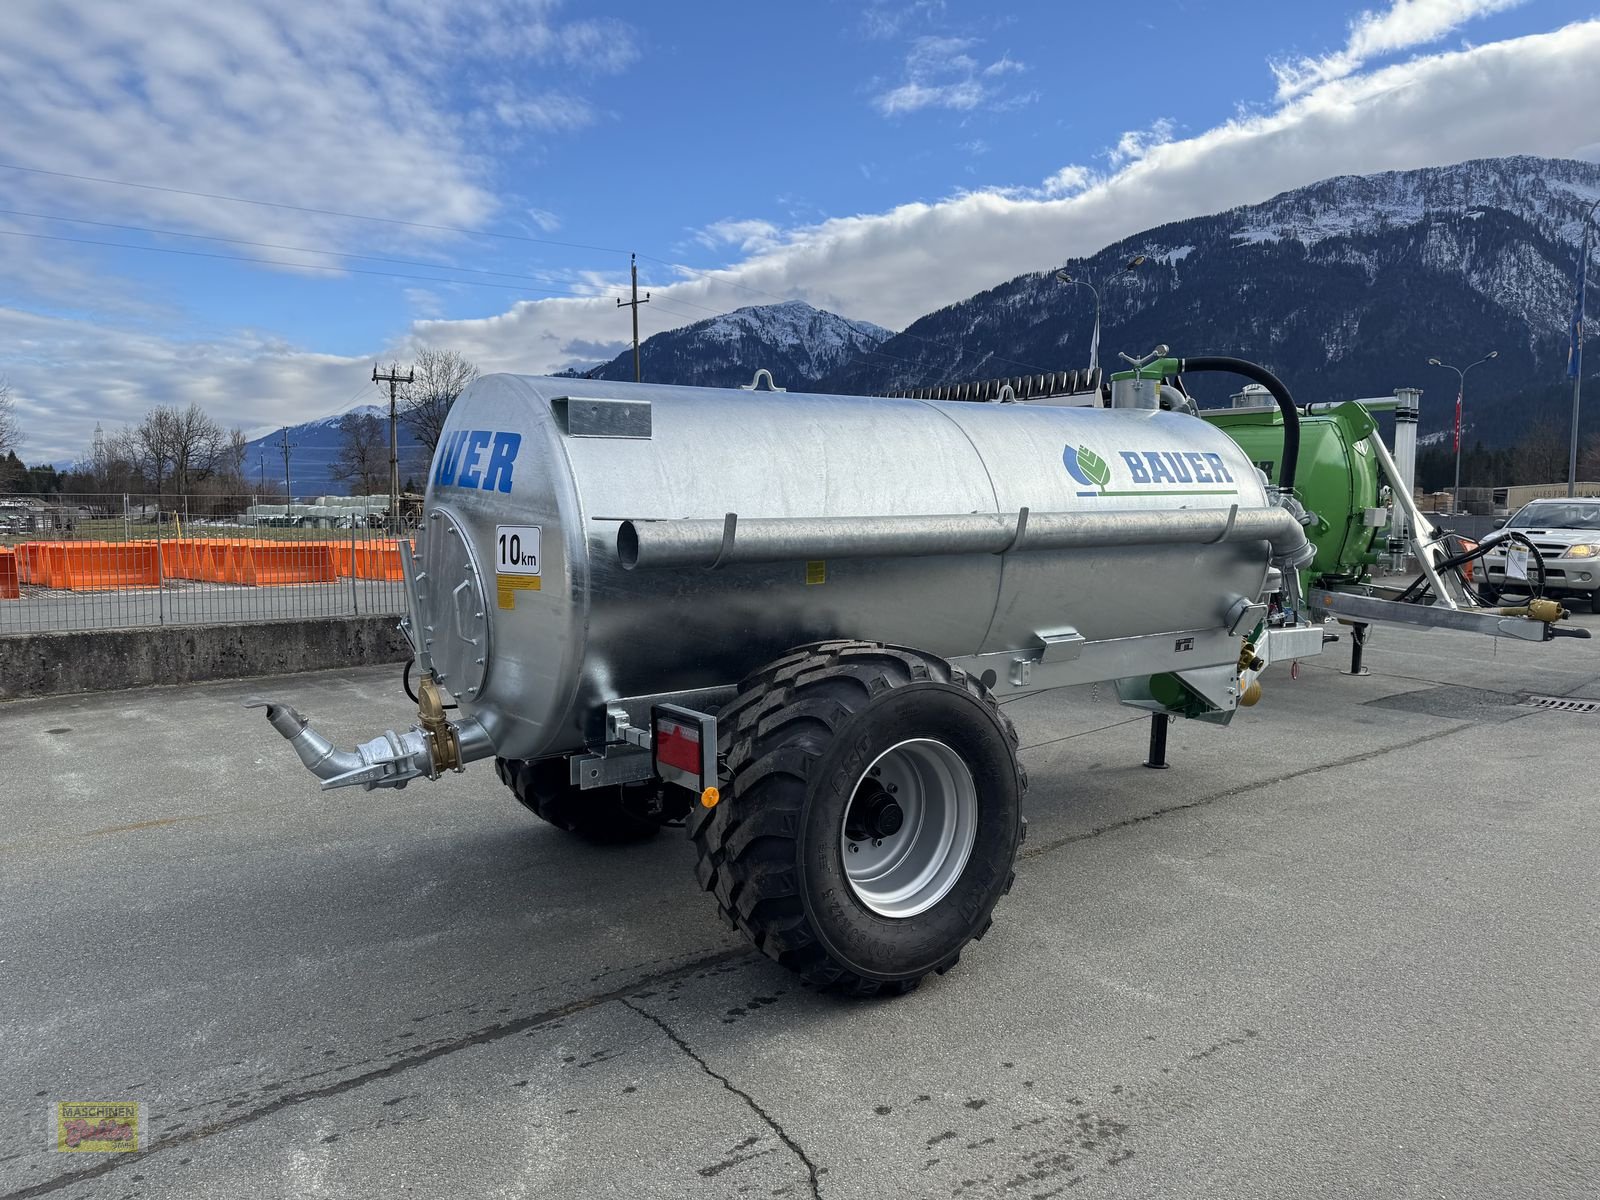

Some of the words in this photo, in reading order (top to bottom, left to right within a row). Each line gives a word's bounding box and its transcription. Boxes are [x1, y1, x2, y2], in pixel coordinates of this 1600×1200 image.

[435, 430, 522, 494] UER
[1118, 451, 1234, 484] BAUER
[499, 534, 521, 565] 10
[521, 552, 537, 566] km
